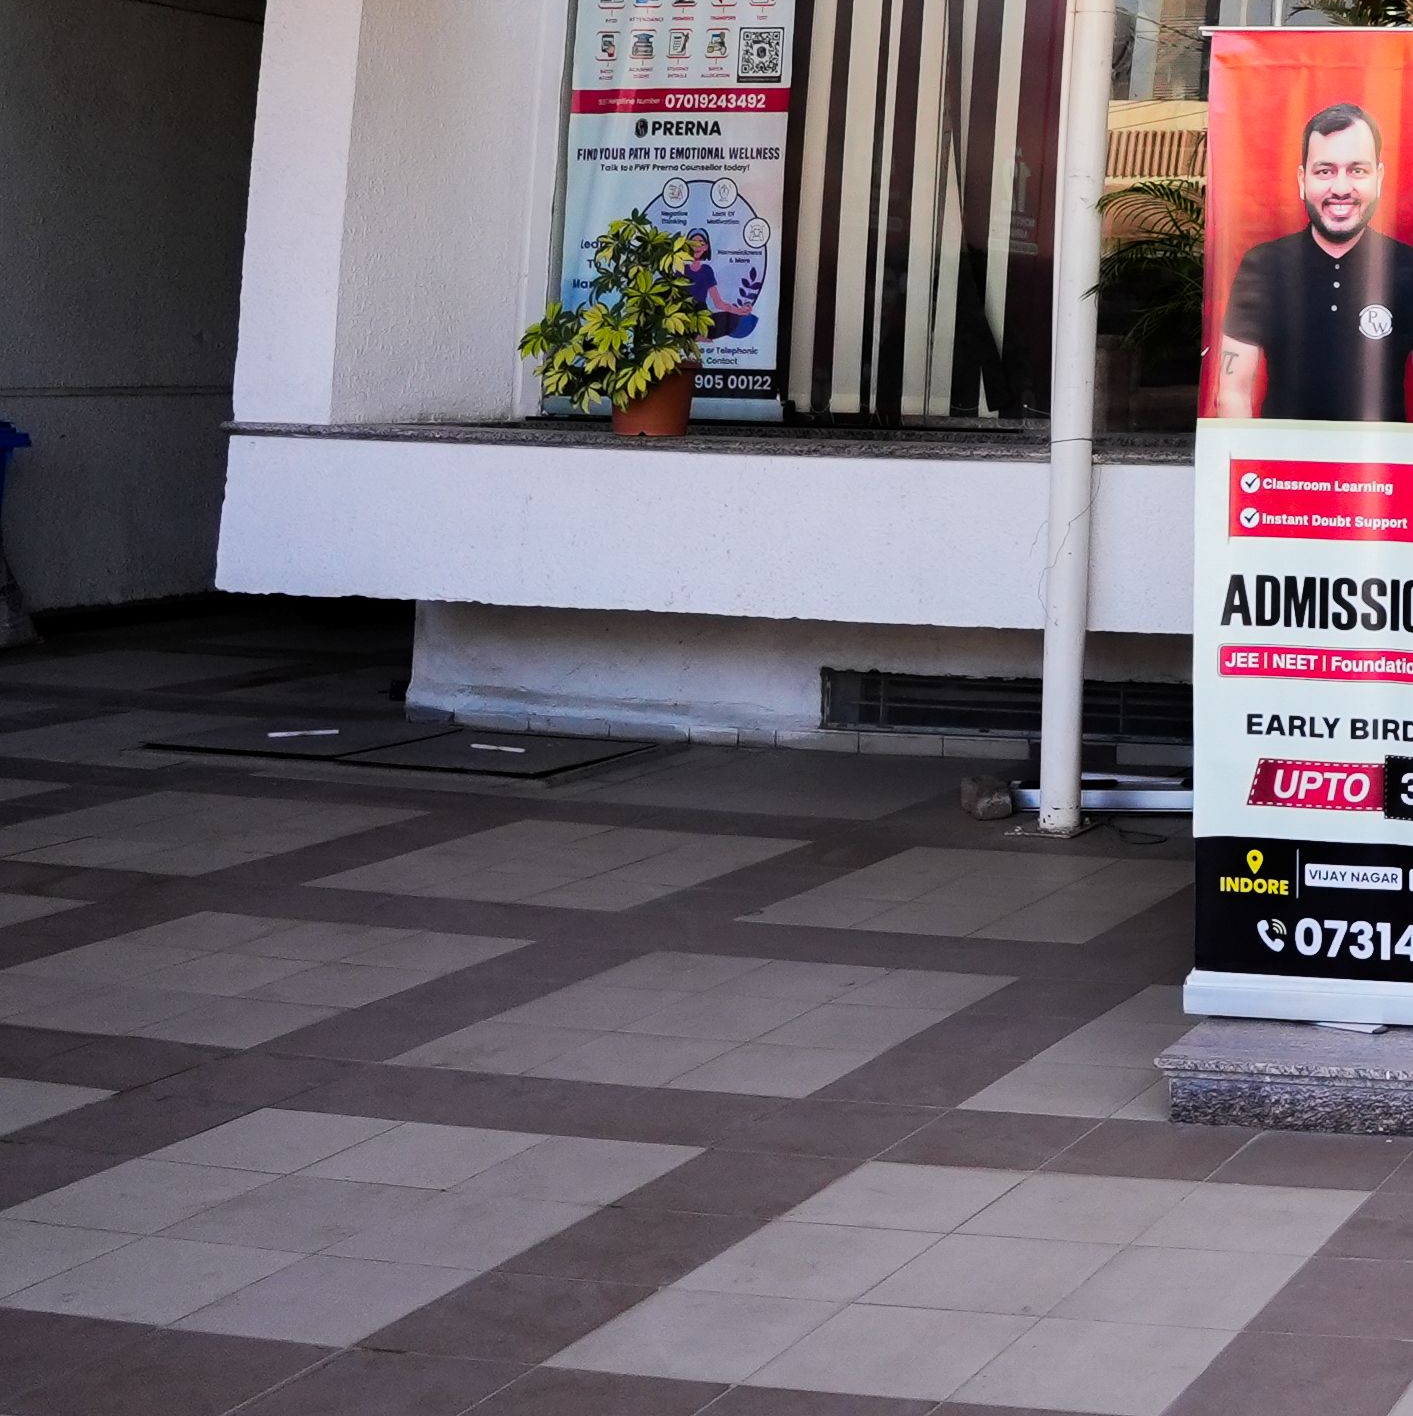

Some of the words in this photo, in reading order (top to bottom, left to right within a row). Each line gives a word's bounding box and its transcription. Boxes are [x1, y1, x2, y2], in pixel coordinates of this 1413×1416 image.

[665, 94, 765, 108] 07019243492
[652, 121, 721, 136] PRERNA
[577, 149, 598, 160] FIND
[599, 149, 625, 160] YOUR
[628, 148, 650, 159] PATH
[654, 148, 666, 159] TO
[669, 147, 725, 159] EMOTIONAL
[729, 147, 780, 159] WELLNESS
[724, 164, 750, 172] today!
[716, 346, 758, 357] Telephonic
[706, 357, 738, 365] Contact
[728, 376, 771, 390] 00122
[1262, 478, 1331, 492] Classroom
[1334, 481, 1393, 495] Learning
[1262, 513, 1309, 527] Instant
[1312, 514, 1351, 528] Doubt
[1355, 516, 1407, 531] Support
[1225, 652, 1259, 670] JEE
[1272, 654, 1318, 671] NEET
[1246, 713, 1341, 739] EARLY
[1273, 770, 1371, 802] UPTO
[1309, 869, 1348, 883] VIJAY
[1351, 870, 1398, 885] NAGAR
[1219, 876, 1289, 896] INDORE
